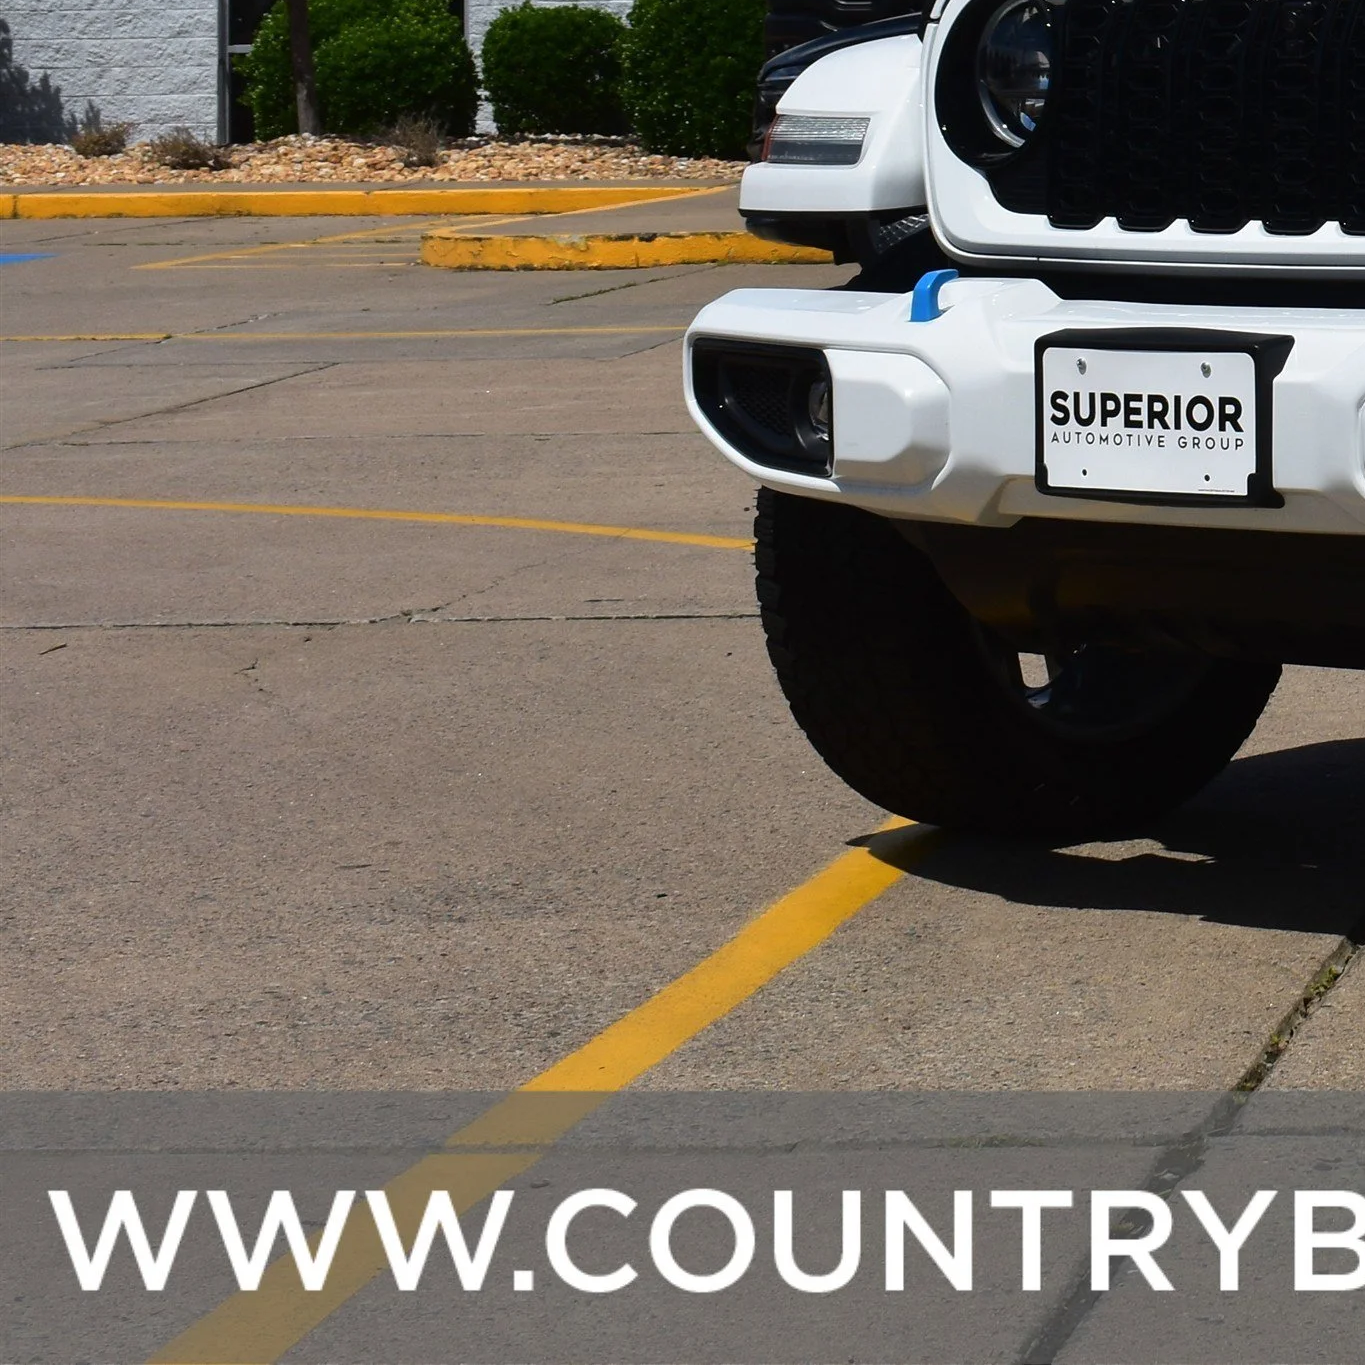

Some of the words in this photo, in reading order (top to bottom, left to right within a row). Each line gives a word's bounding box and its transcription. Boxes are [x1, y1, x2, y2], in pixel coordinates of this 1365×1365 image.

[1050, 390, 1244, 433] SUPERIOR
[1051, 432, 1166, 448] AUTOMOTIVE
[1178, 436, 1244, 451] GROUP
